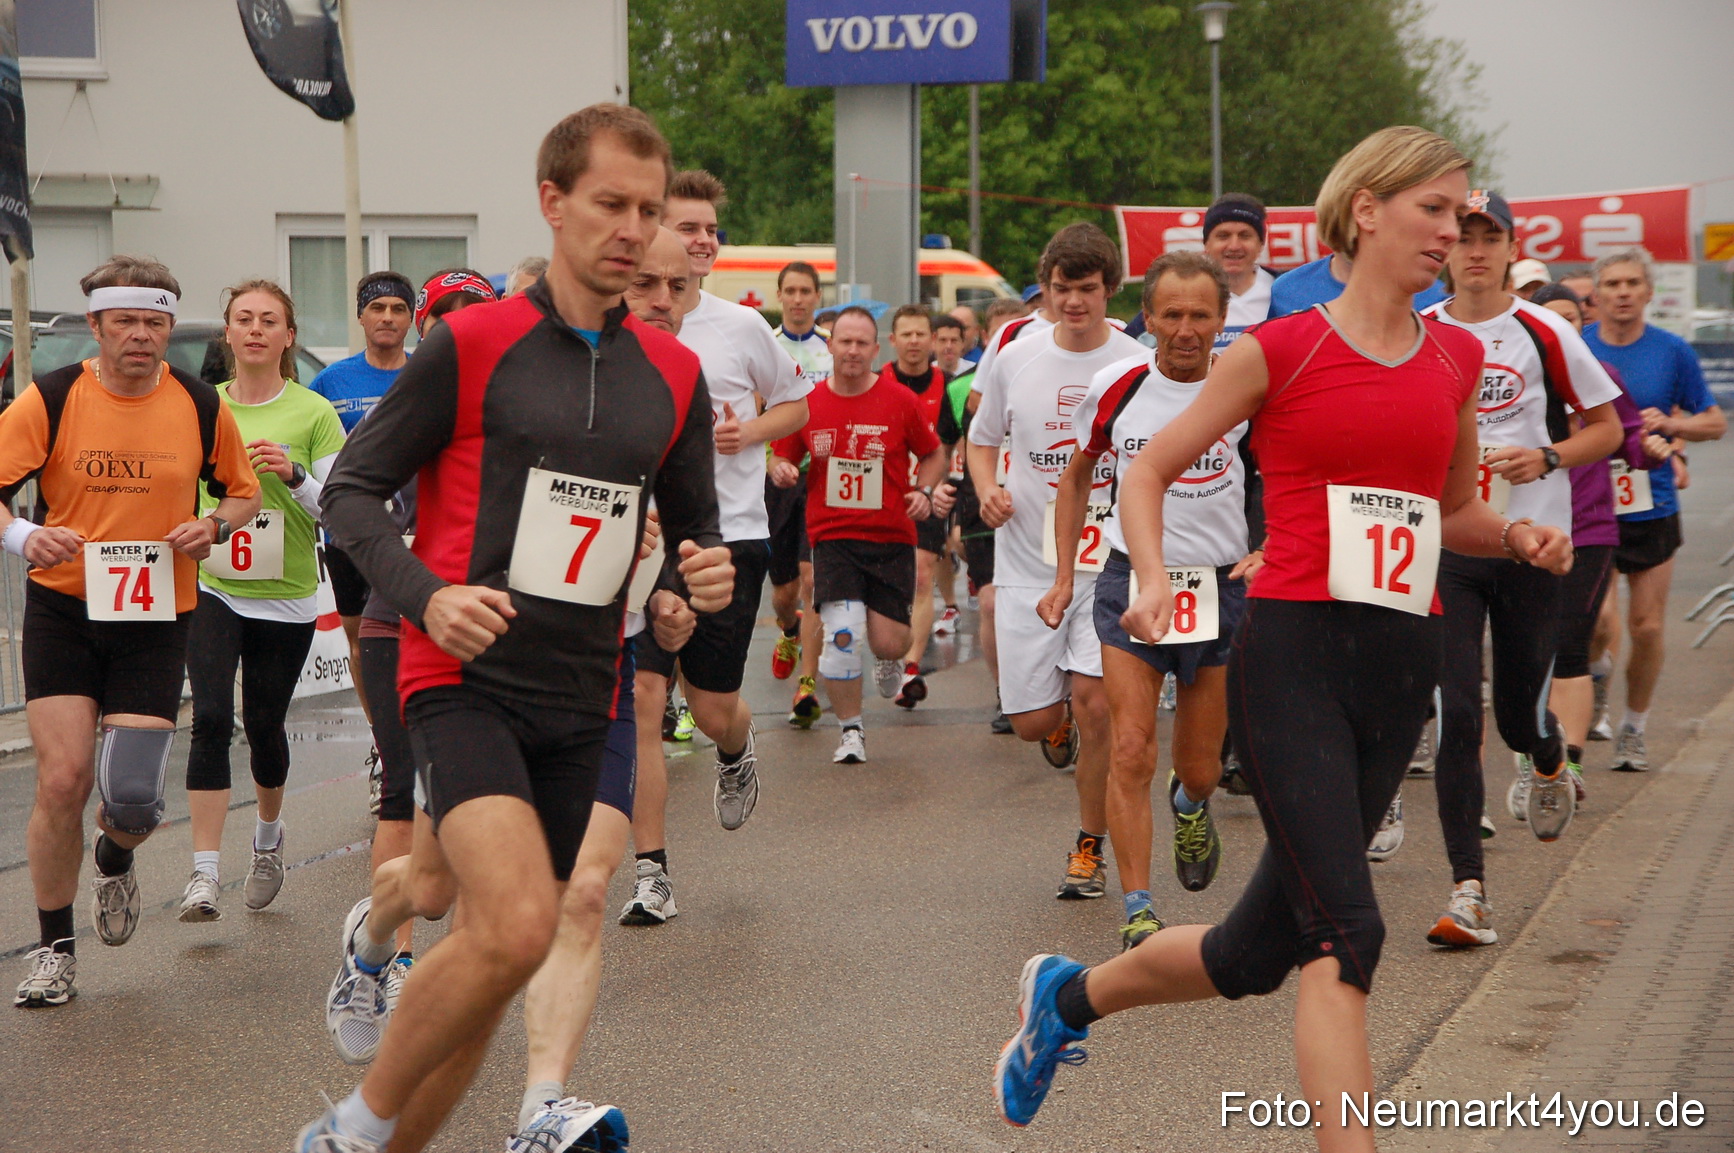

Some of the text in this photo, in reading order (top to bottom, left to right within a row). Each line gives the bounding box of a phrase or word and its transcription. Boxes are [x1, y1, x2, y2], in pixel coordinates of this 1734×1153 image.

[806, 12, 978, 52] VOLVO
[1044, 421, 1073, 431] SE
[86, 459, 152, 479] OEXL
[550, 479, 611, 503] MEYER
[838, 472, 864, 501] 31
[1197, 479, 1233, 499] Autohaus
[549, 493, 609, 514] WERBUNG
[1350, 492, 1404, 511] MEYER
[1350, 505, 1405, 521] WERBUNG
[100, 545, 142, 555] MEYER
[231, 530, 252, 571] 6
[564, 514, 603, 585] 7
[1366, 523, 1415, 595] 12
[108, 566, 154, 611] 74
